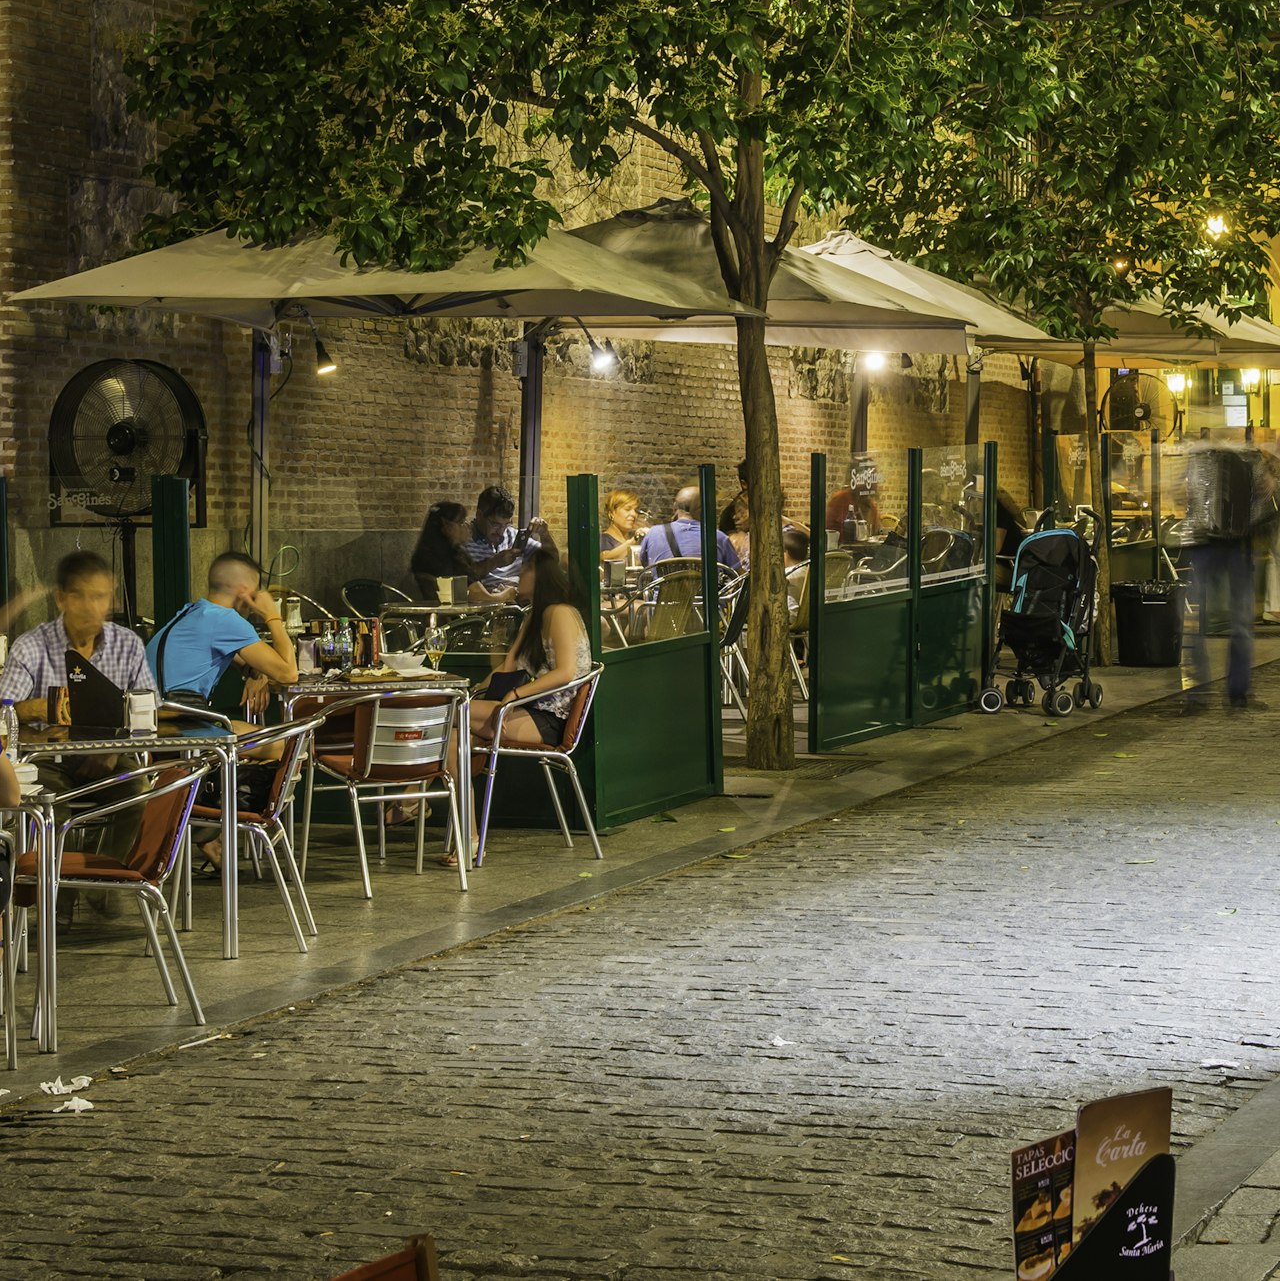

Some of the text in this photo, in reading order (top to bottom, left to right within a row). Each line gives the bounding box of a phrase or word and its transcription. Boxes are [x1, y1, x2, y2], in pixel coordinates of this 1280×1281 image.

[1113, 1124, 1131, 1142] La
[1016, 1146, 1045, 1165] TAPAS
[1095, 1131, 1148, 1167] Carta
[1127, 1202, 1158, 1218] Dehesa
[1119, 1239, 1164, 1258] Santa María
